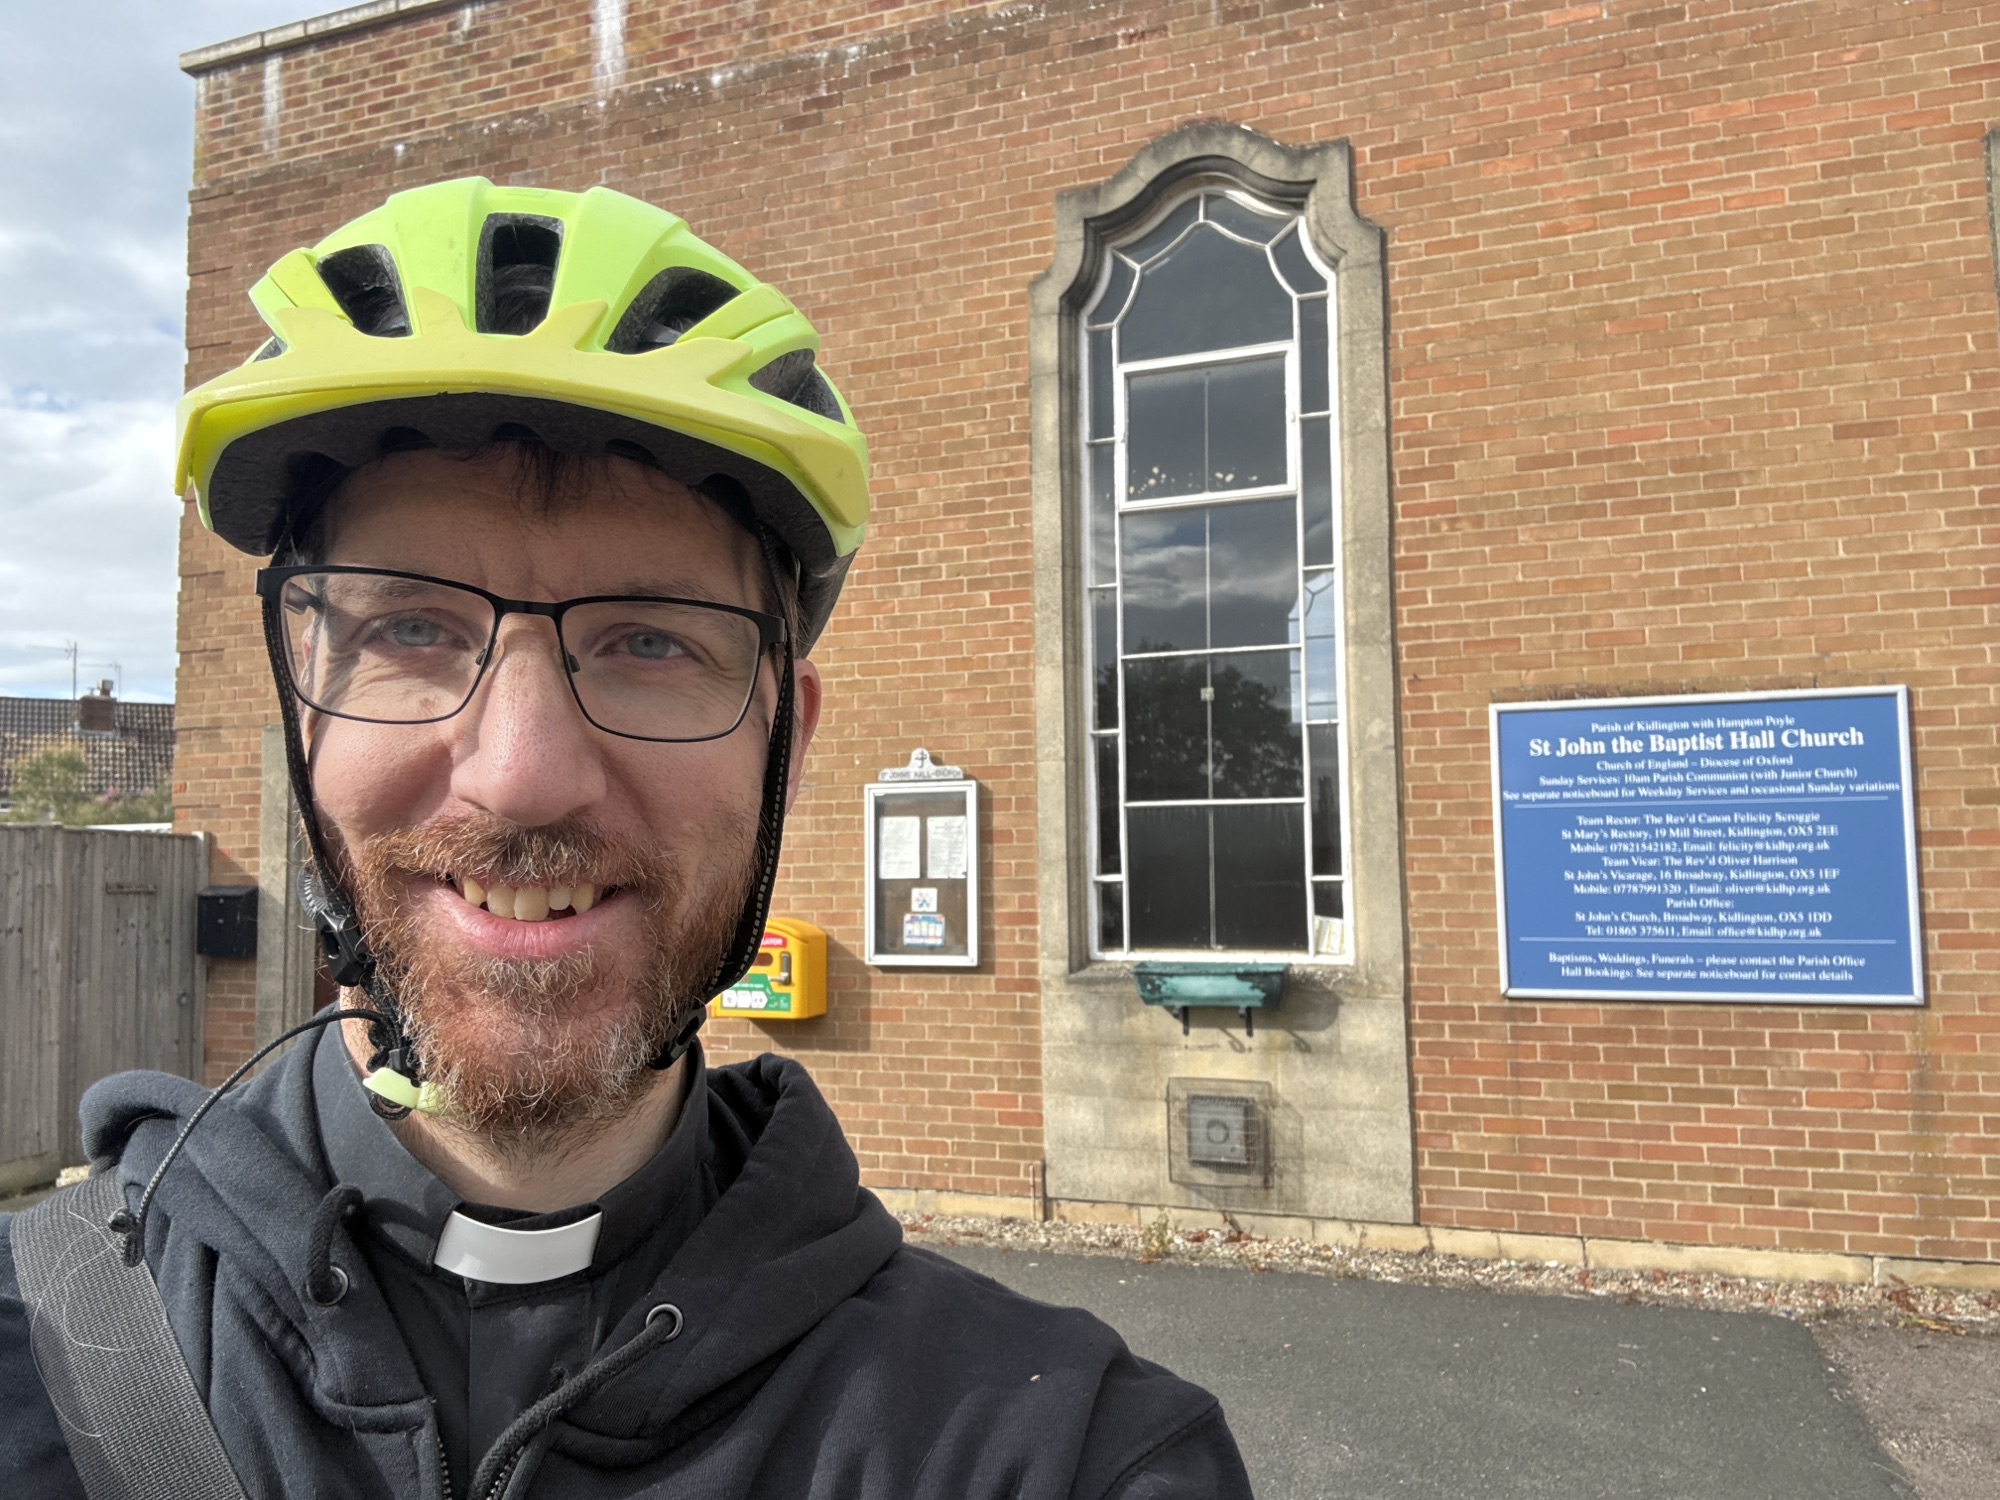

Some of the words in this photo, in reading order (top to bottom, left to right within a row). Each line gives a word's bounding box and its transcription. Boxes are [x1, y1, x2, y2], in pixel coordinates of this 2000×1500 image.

[1591, 722, 1621, 734] Parish
[1623, 721, 1635, 732] of
[1636, 719, 1689, 733] Kidlington
[1692, 718, 1714, 729] with
[1716, 717, 1763, 730] Hampton
[1765, 714, 1796, 728] Poyle
[1529, 737, 1552, 757] St
[1555, 736, 1606, 758] John
[1611, 735, 1644, 754] the
[1649, 732, 1724, 756] Baptist
[1730, 729, 1775, 750] Hall
[1781, 726, 1865, 748] Church
[1596, 760, 1633, 771] Church
[1634, 759, 1646, 770] of
[1647, 757, 1688, 772] England
[1700, 757, 1741, 769] Diocese
[1742, 756, 1754, 767] of
[1756, 754, 1793, 767] Oxford
[1539, 775, 1574, 788] Sunday
[1577, 774, 1621, 786] Services:
[1624, 773, 1650, 784] 10am
[1653, 771, 1684, 783] Parish
[1686, 770, 1748, 782] Communion
[1750, 769, 1778, 782] (with
[1779, 768, 1812, 780] Junior
[1814, 767, 1858, 779] Church)
[1503, 790, 1520, 801] See
[1522, 789, 1561, 801] separate
[1562, 788, 1619, 800] noticeboard
[1621, 787, 1636, 798] for
[1638, 785, 1683, 799] Weekday
[1685, 785, 1728, 797] Services
[1730, 784, 1749, 796] and
[1751, 782, 1805, 794] occasional
[1807, 781, 1846, 794] Sunday
[1848, 780, 1900, 792] variations
[1576, 815, 1604, 826] Team
[1606, 814, 1641, 826] Rector:
[1643, 814, 1664, 825] The
[1697, 812, 1731, 824] Canon
[1733, 812, 1772, 825] Felicity
[1775, 811, 1821, 824] Scroggie
[1561, 829, 1572, 840] St
[1610, 829, 1652, 840] Rectory,
[1655, 828, 1667, 838] 19
[1669, 827, 1690, 838] Mill
[1692, 827, 1726, 838] Street,
[1728, 827, 1787, 839] Kidlington,
[1788, 825, 1813, 836] OX5
[1570, 843, 1608, 854] Mobile:
[1683, 840, 1715, 853] Email:
[1601, 856, 1629, 867] Team
[1631, 856, 1661, 867] Vicar:
[1663, 855, 1683, 866] The
[1718, 855, 1751, 866] Oliver
[1753, 855, 1798, 866] Harrison
[1564, 870, 1575, 881] St
[1610, 870, 1657, 882] Vicarage,
[1659, 870, 1672, 880] 16
[1673, 868, 1728, 883] Broadway,
[1730, 869, 1789, 881] Kidlington,
[1790, 869, 1815, 880] OX5
[1573, 884, 1611, 895] Mobile:
[1689, 883, 1723, 895] Email:
[1666, 898, 1697, 909] Parish
[1699, 898, 1735, 909] Office:
[1575, 912, 1586, 922] St
[1621, 912, 1661, 924] Church,
[1663, 911, 1717, 925] Broadway,
[1718, 912, 1778, 925] Kidlington,
[1778, 912, 1804, 923] OX5
[1585, 926, 1604, 936] Tel:
[1682, 925, 1716, 938] Email:
[1548, 952, 1597, 965] Baptisms,
[1597, 952, 1650, 966] Weddings,
[1651, 953, 1694, 965] Funerals
[1705, 954, 1737, 967] please
[1739, 955, 1777, 966] contact
[1779, 954, 1795, 966] the
[1797, 954, 1830, 967] Parish
[1832, 955, 1866, 967] Office
[1561, 966, 1582, 977] Hall
[1584, 967, 1634, 980] Bookings:
[1636, 967, 1654, 978] See
[1656, 968, 1697, 981] separate
[1699, 967, 1758, 981] noticeboard
[1761, 969, 1777, 980] for
[1779, 970, 1816, 981] contact
[1818, 970, 1853, 981] details
